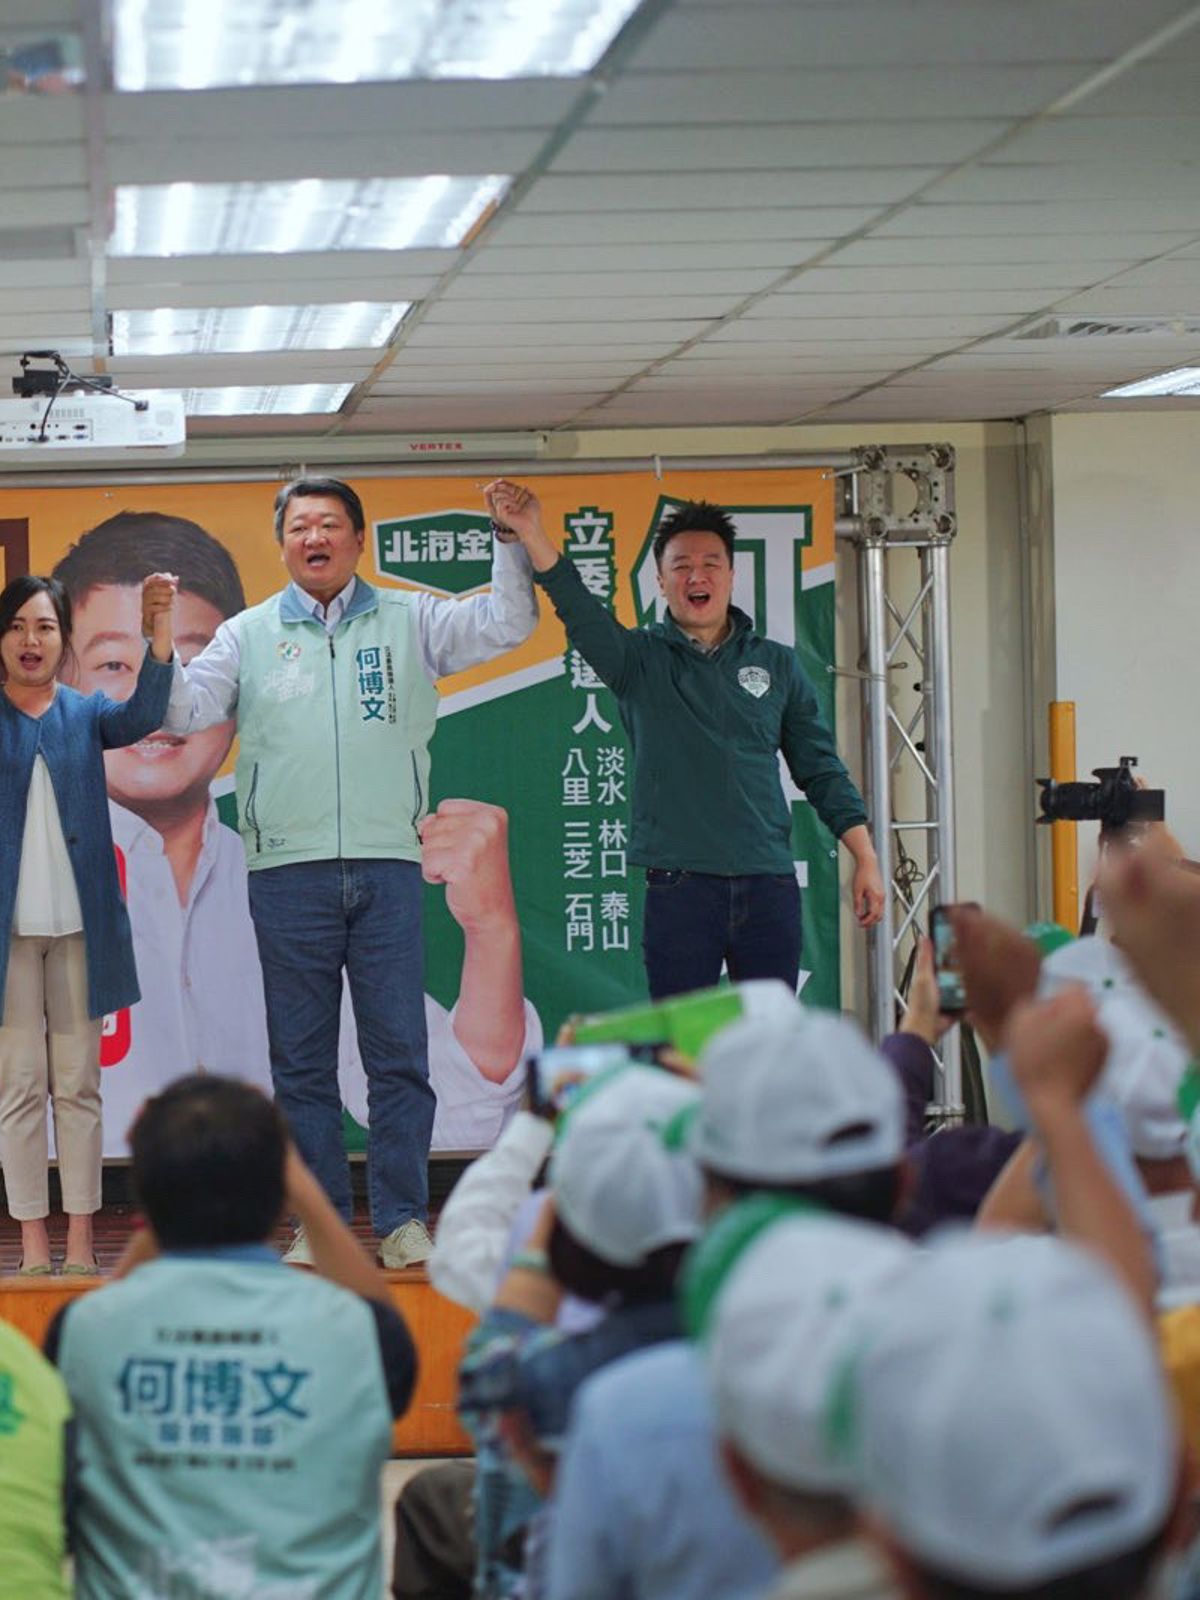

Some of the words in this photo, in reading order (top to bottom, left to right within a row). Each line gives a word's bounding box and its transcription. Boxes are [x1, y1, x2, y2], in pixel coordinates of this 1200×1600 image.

[409, 443, 463, 451] VERTEX
[356, 646, 386, 721] 何博文
[561, 747, 592, 806] 八里
[596, 746, 627, 806] 淡水
[563, 821, 593, 879] 三芝
[598, 818, 628, 878] 林口
[564, 892, 595, 951] 石門
[600, 890, 630, 951] 泰山
[117, 1357, 312, 1420] 何博文
